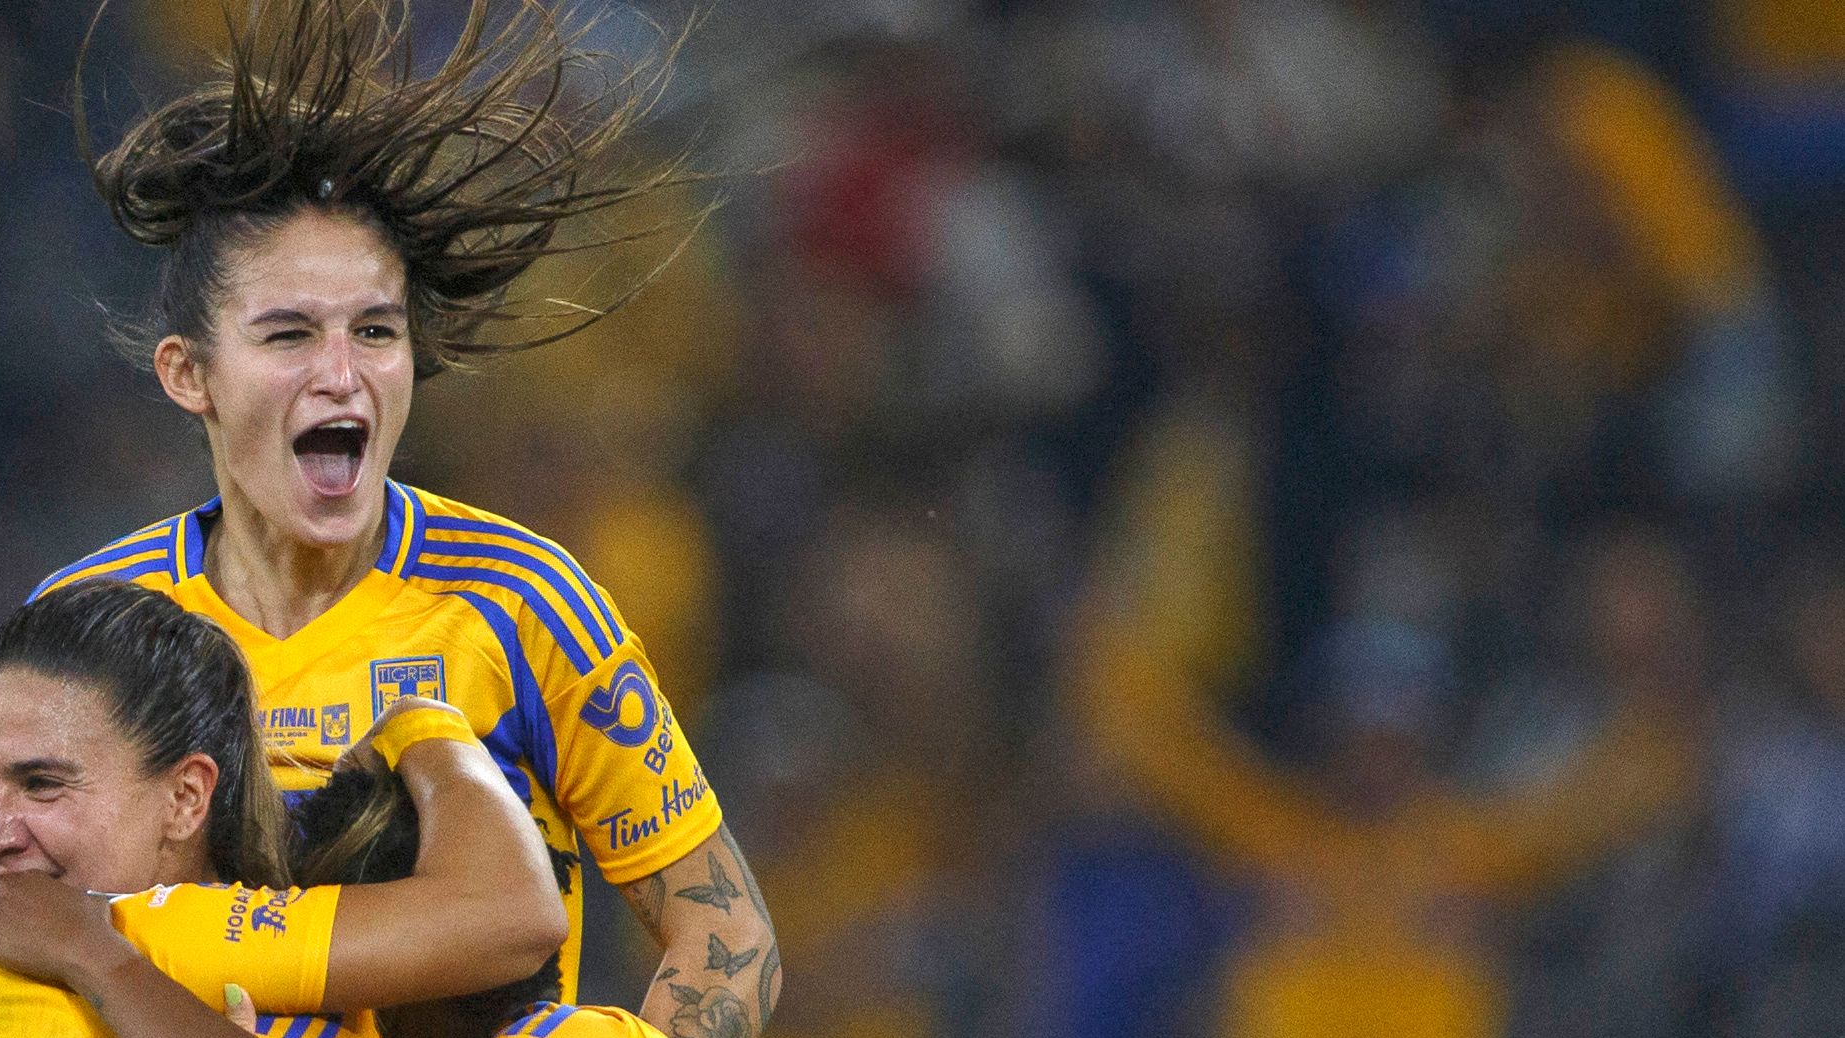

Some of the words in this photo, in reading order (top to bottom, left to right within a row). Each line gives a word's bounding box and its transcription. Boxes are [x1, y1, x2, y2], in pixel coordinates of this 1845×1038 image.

[378, 665, 437, 683] TIGRES
[270, 707, 317, 728] FINAL
[597, 807, 660, 850] Tim
[661, 763, 708, 825] Hort
